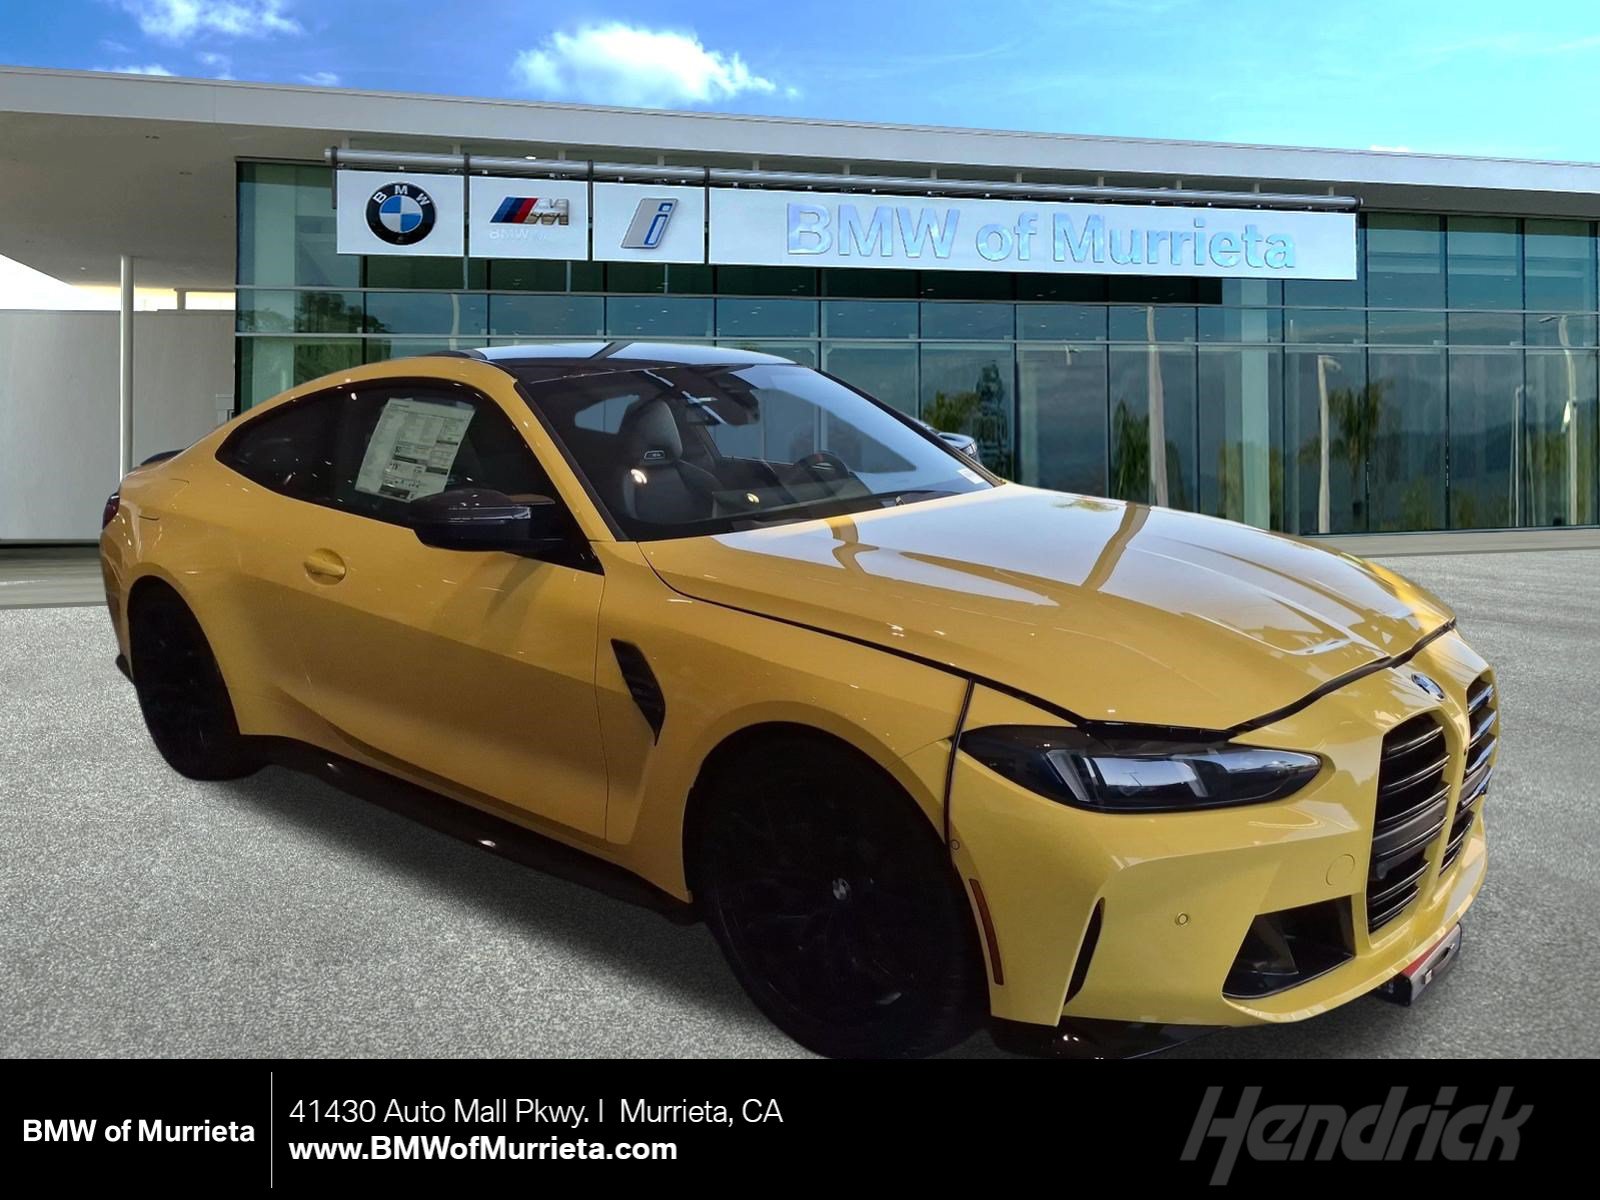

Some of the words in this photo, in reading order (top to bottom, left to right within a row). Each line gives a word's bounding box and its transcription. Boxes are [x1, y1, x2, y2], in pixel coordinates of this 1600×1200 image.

[371, 183, 431, 207] BMW
[786, 202, 961, 259] BMW
[975, 211, 1039, 262] of
[1052, 212, 1297, 269] Murrieta
